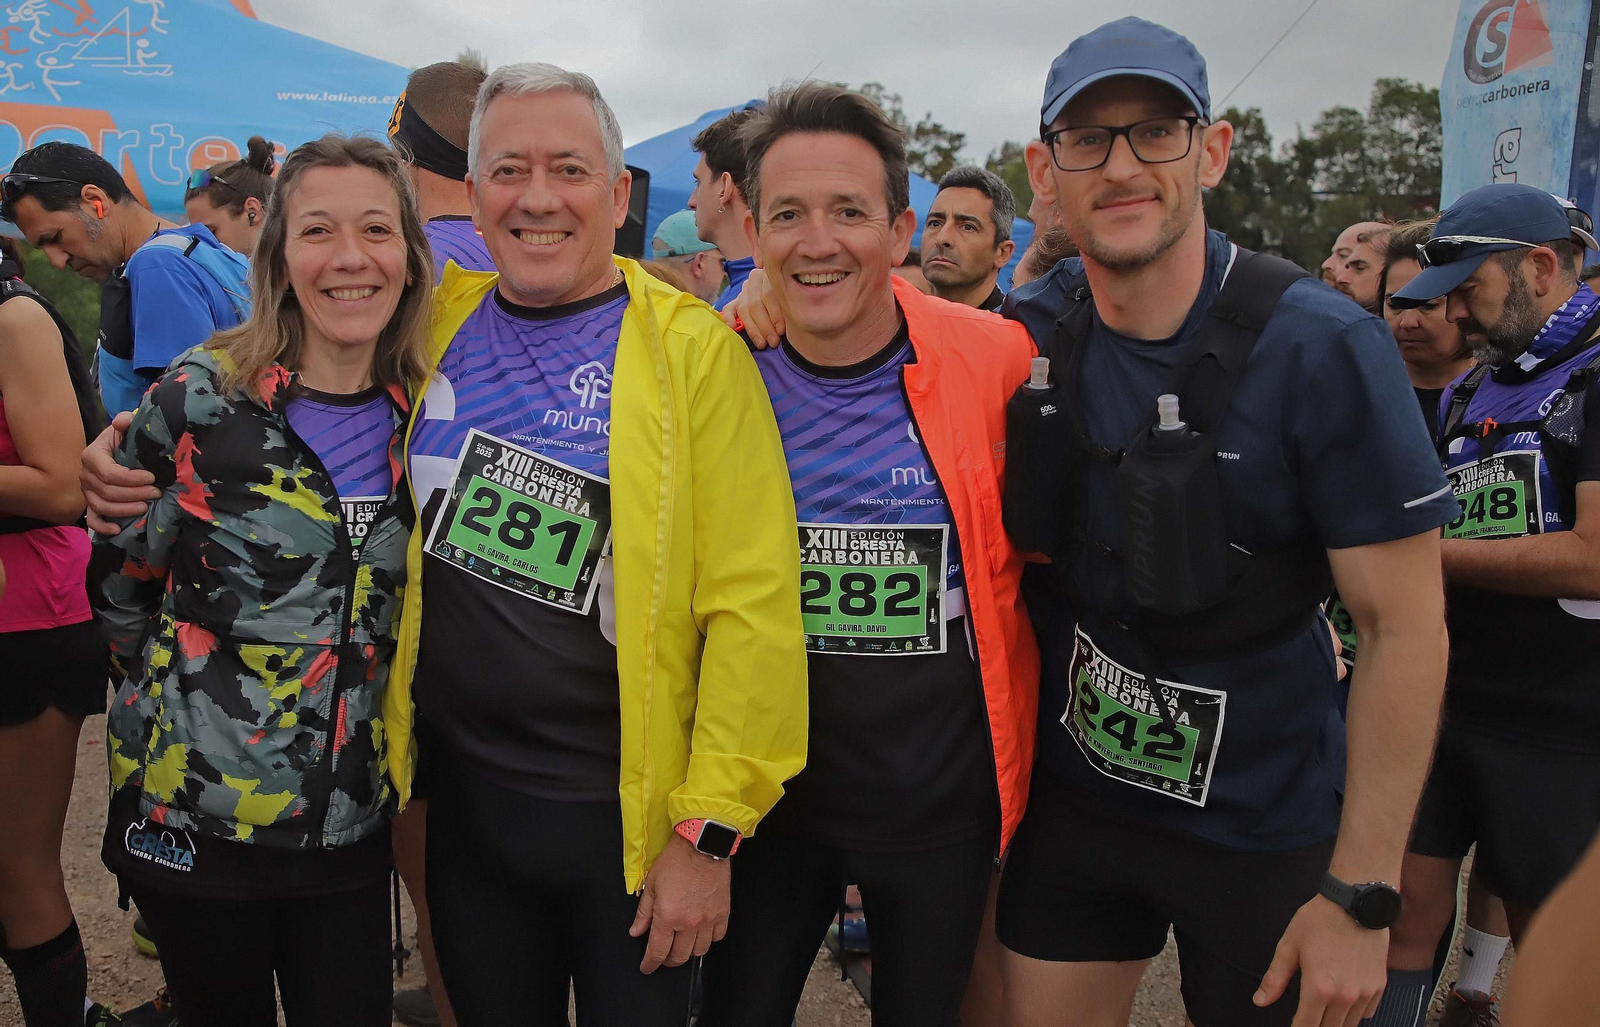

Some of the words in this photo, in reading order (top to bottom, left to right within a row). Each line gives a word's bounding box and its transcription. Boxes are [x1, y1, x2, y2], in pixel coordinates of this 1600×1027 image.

[475, 447, 492, 458] 2025
[512, 433, 585, 451] MANTENIMIENTO
[495, 447, 534, 478] XIII
[1478, 464, 1505, 479] CRESTA
[531, 471, 582, 499] CRESTA
[534, 462, 586, 488] EDICIÓN
[1453, 470, 1516, 496] CARBONERA
[1458, 467, 1478, 485] XIII
[482, 463, 590, 517] CARBONERA
[356, 512, 377, 522] CR
[460, 487, 583, 567] 281
[806, 529, 847, 549] XIII
[850, 530, 905, 540] EDICIÓN
[850, 540, 905, 551] CRESTA
[477, 543, 487, 554] GIL
[487, 547, 510, 565] GAVIRA,
[512, 558, 539, 574] CARLOS
[800, 550, 919, 565] CARBONERA
[801, 570, 921, 617] 282
[825, 623, 836, 631] GIL
[838, 624, 864, 633] GAVIRA,
[866, 625, 887, 633] DAVID
[1090, 650, 1122, 687] XIII
[1078, 681, 1186, 764] 242
[1129, 758, 1163, 771] SANTIAGO
[131, 832, 194, 867] CRESTA
